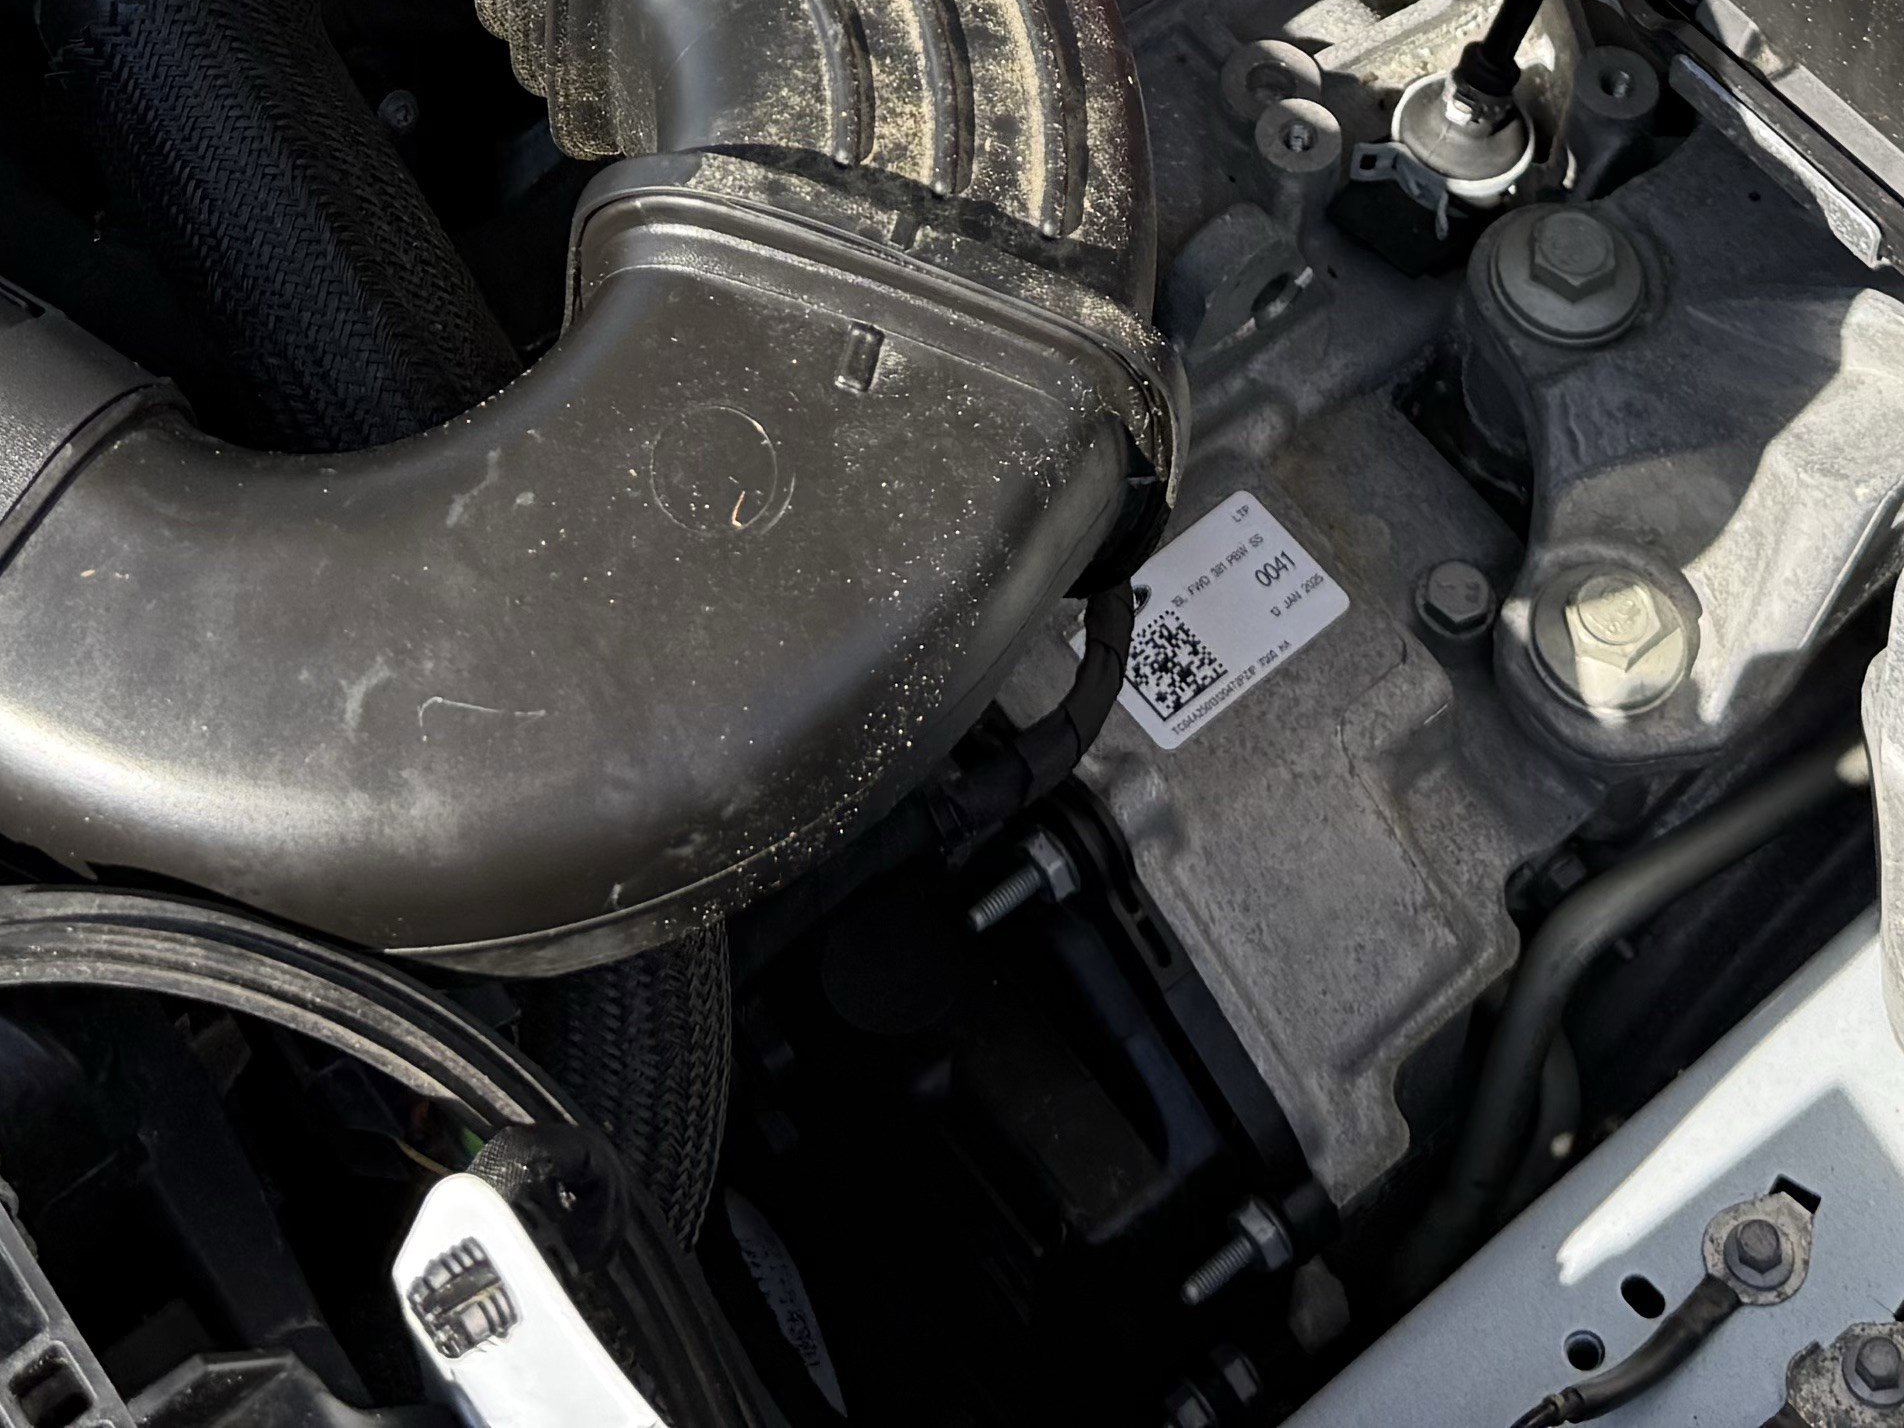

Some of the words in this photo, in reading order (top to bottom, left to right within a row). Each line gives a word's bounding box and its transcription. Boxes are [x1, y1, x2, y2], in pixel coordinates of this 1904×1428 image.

[1185, 573, 1211, 596] FWD
[1247, 531, 1265, 548] SS
[1252, 548, 1296, 589] 0041
[1280, 588, 1302, 609] JAN
[1299, 570, 1324, 594] 2025
